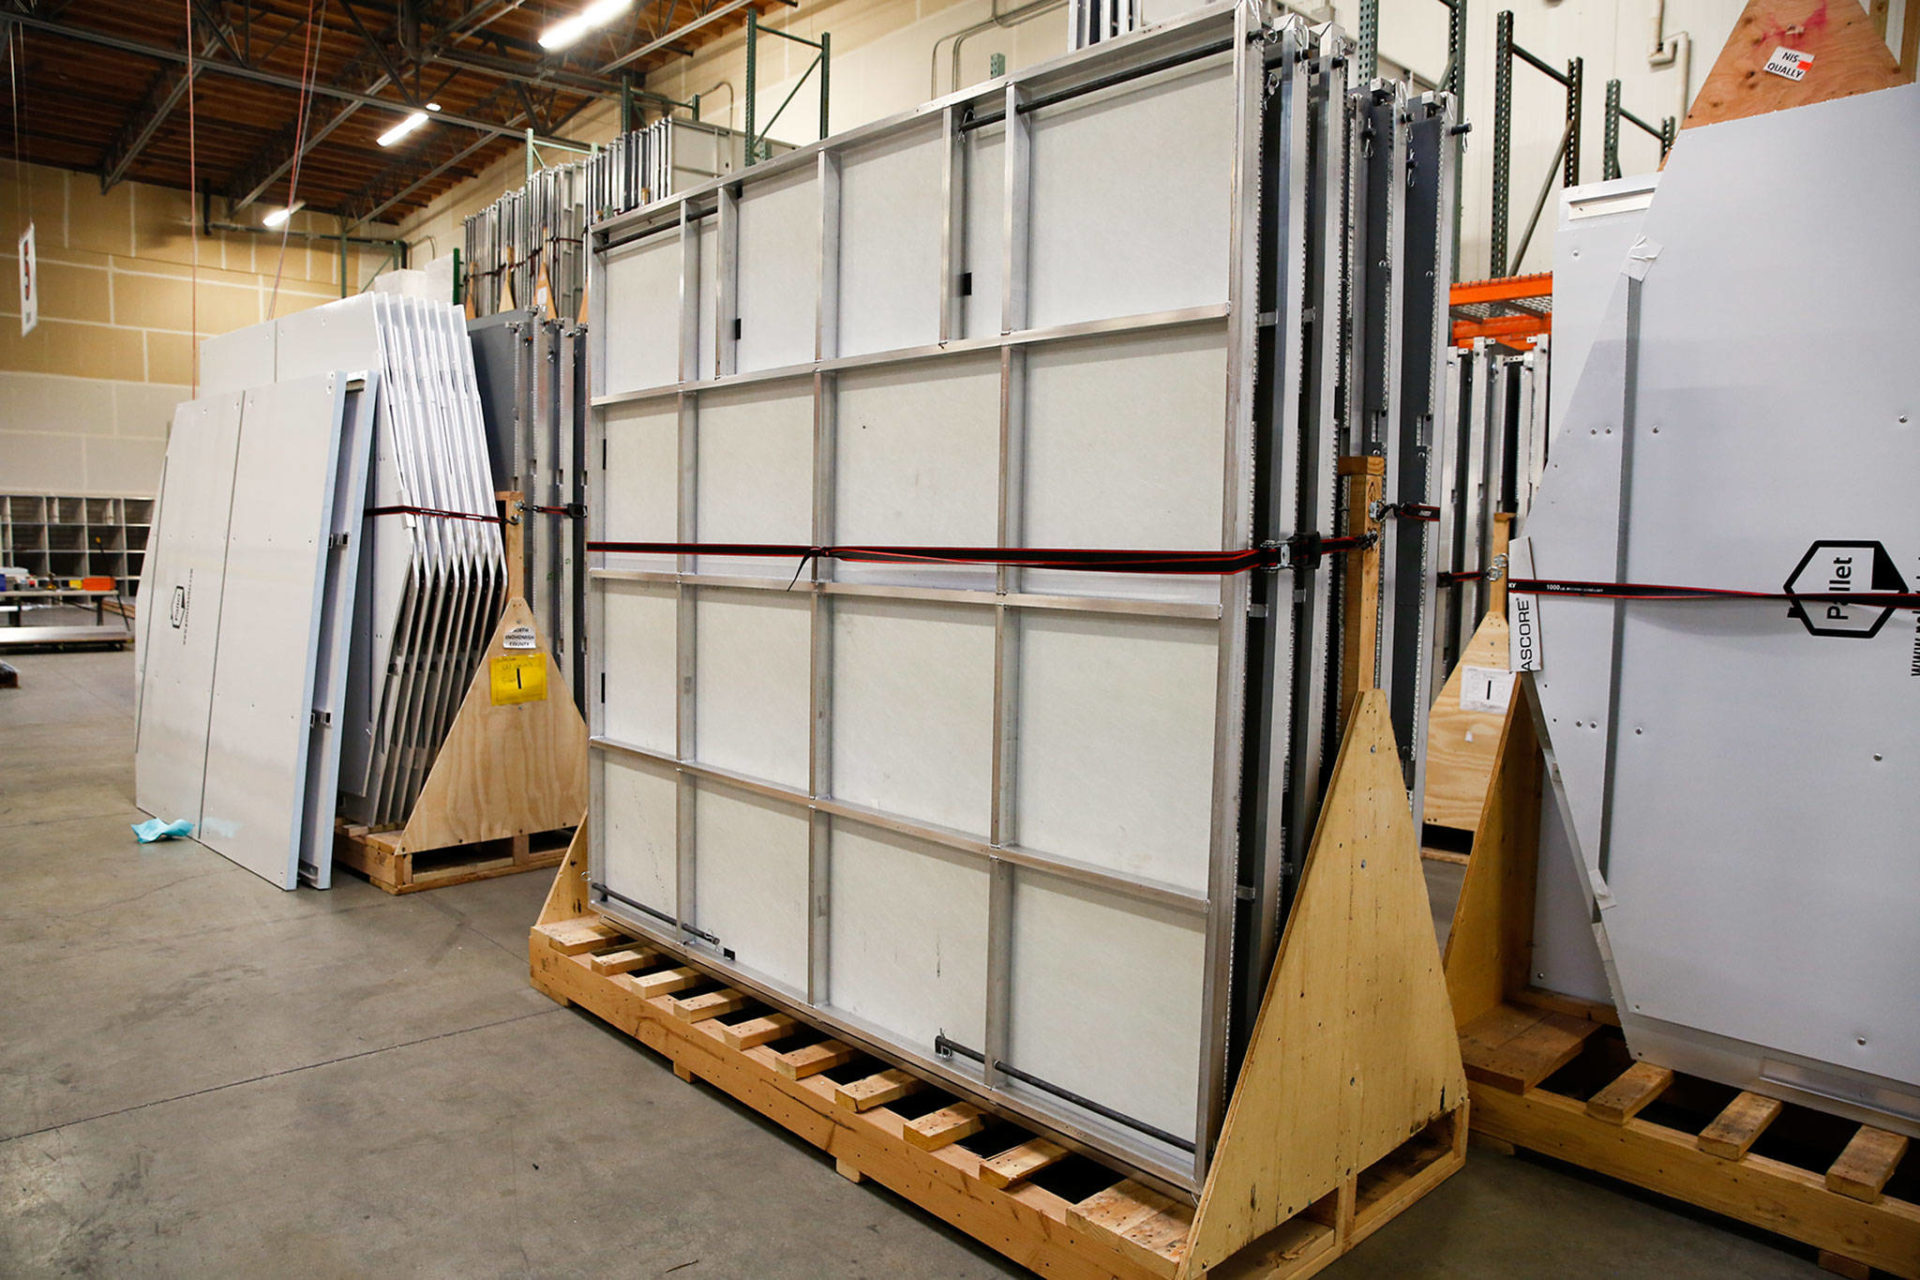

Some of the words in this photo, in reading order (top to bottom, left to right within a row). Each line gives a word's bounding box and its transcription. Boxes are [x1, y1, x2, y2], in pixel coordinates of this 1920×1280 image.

[1767, 62, 1804, 78] QUALLY
[1827, 557, 1852, 620] Pllet
[1518, 600, 1533, 672] ASCORE
